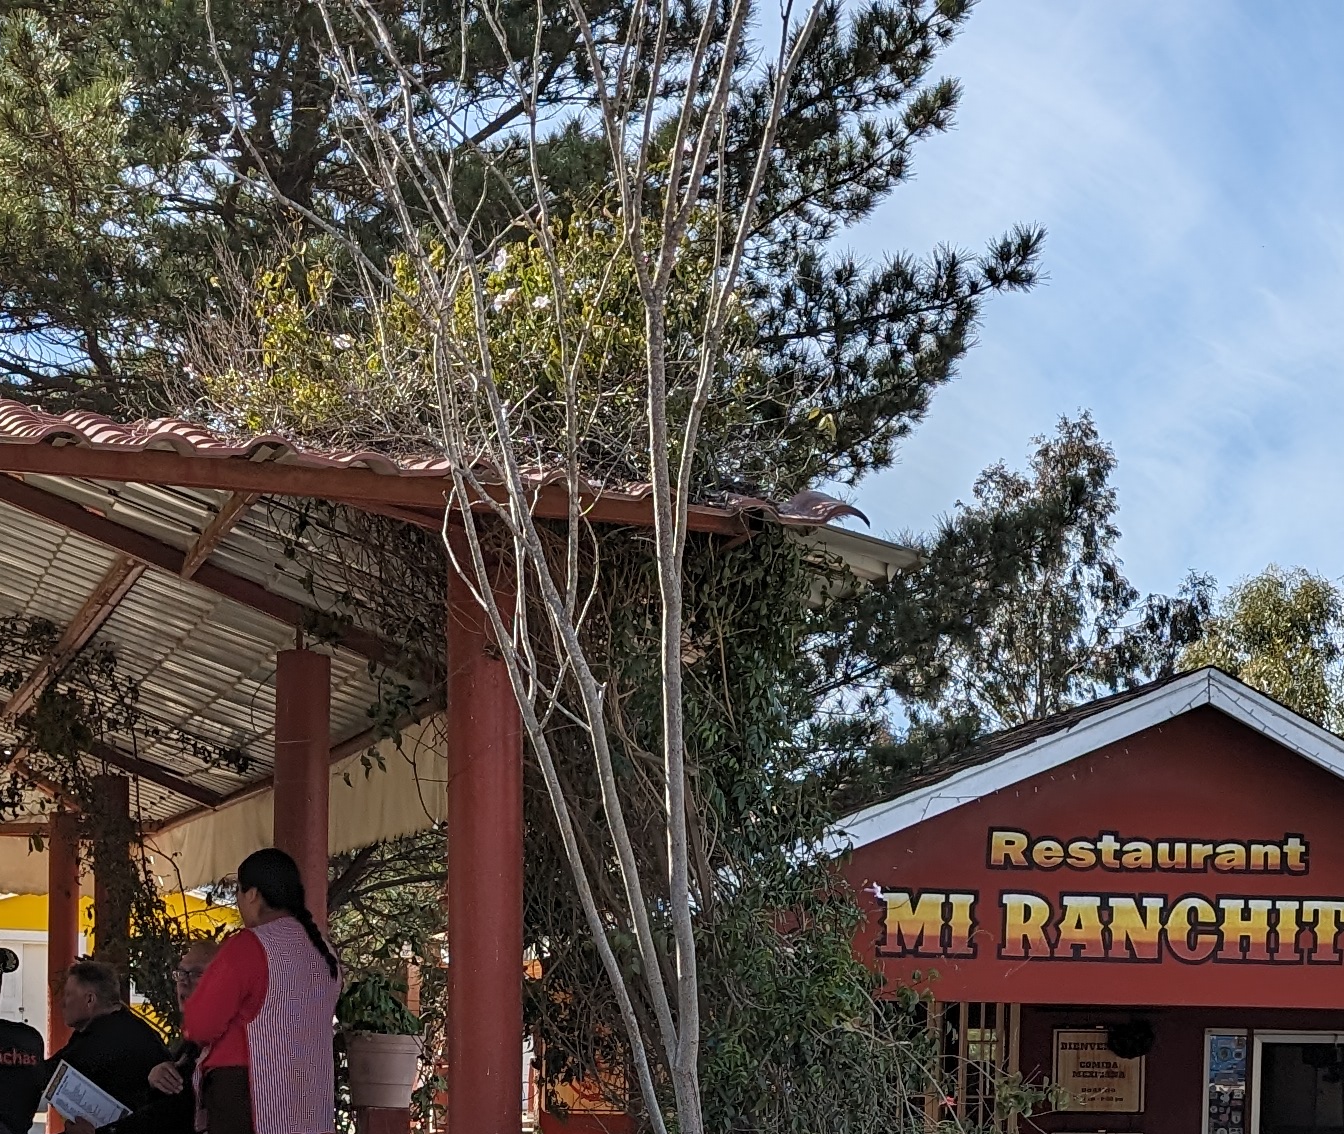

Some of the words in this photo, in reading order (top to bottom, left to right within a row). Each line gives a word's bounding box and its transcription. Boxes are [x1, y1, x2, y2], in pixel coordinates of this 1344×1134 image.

[988, 828, 1308, 874] Restaurant
[878, 889, 977, 958] MI
[1079, 1061, 1118, 1069] COMIDA
